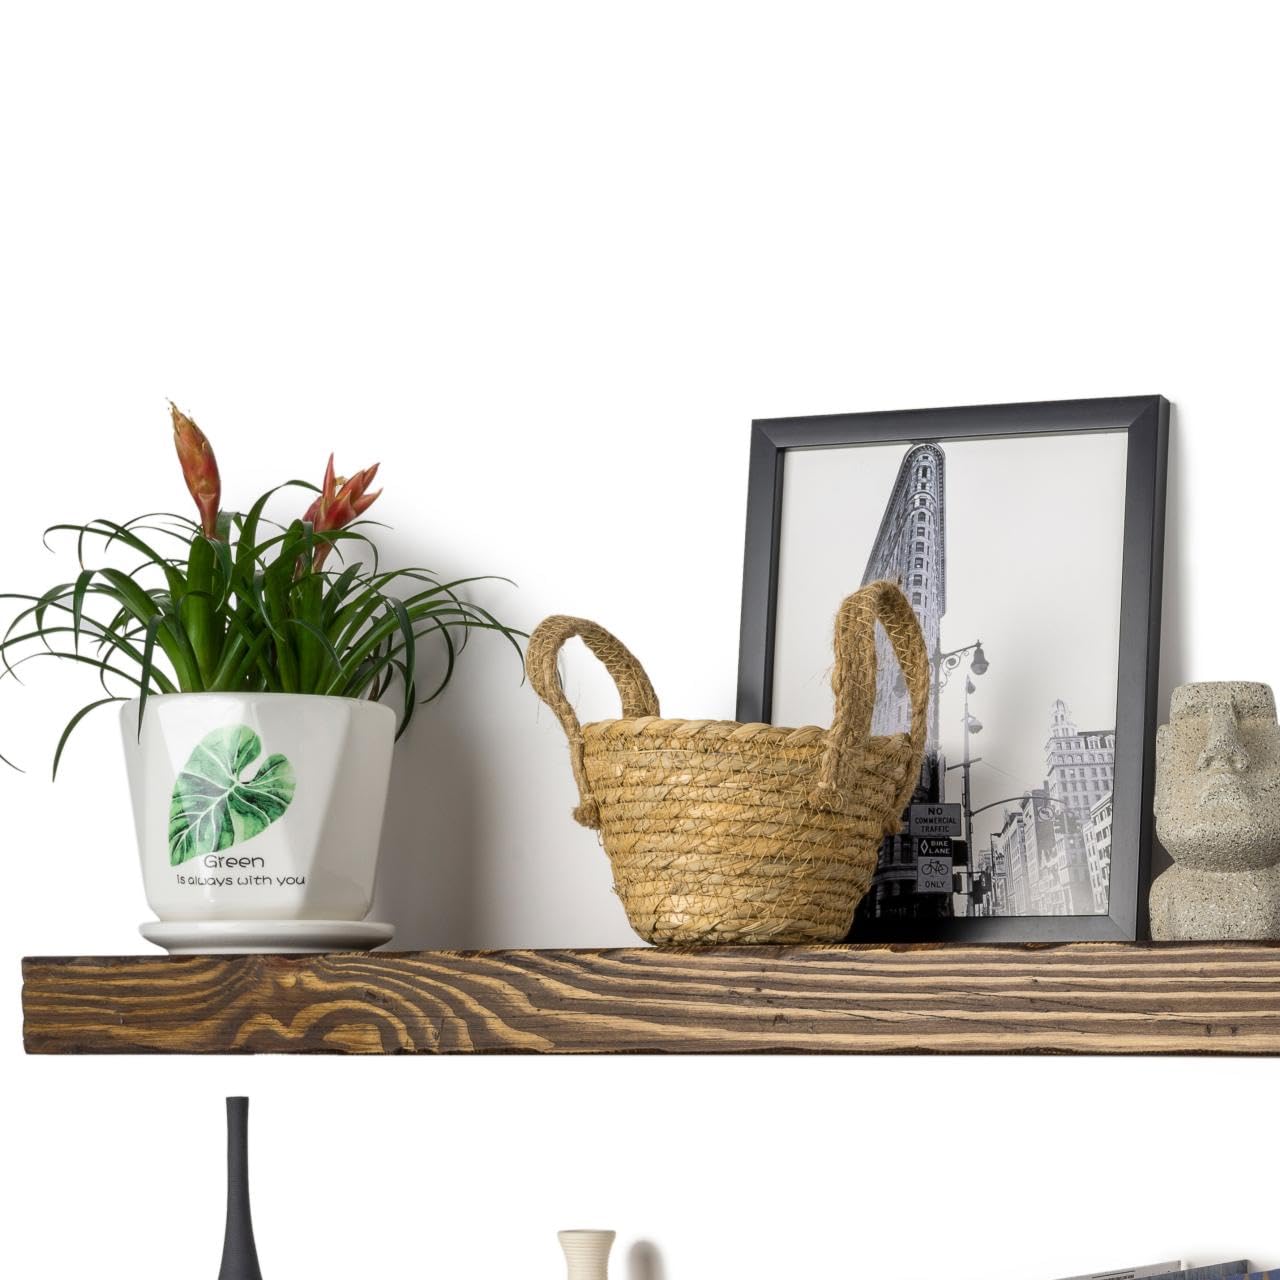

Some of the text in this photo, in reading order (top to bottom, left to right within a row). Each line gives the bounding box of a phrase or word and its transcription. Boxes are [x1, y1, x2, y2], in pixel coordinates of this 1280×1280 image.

[928, 807, 943, 816] NO
[921, 825, 950, 833] TRAFFIC
[928, 847, 951, 855] LANE
[204, 854, 265, 869] Green
[188, 875, 233, 887] always
[237, 875, 273, 886] with
[276, 876, 306, 887] you
